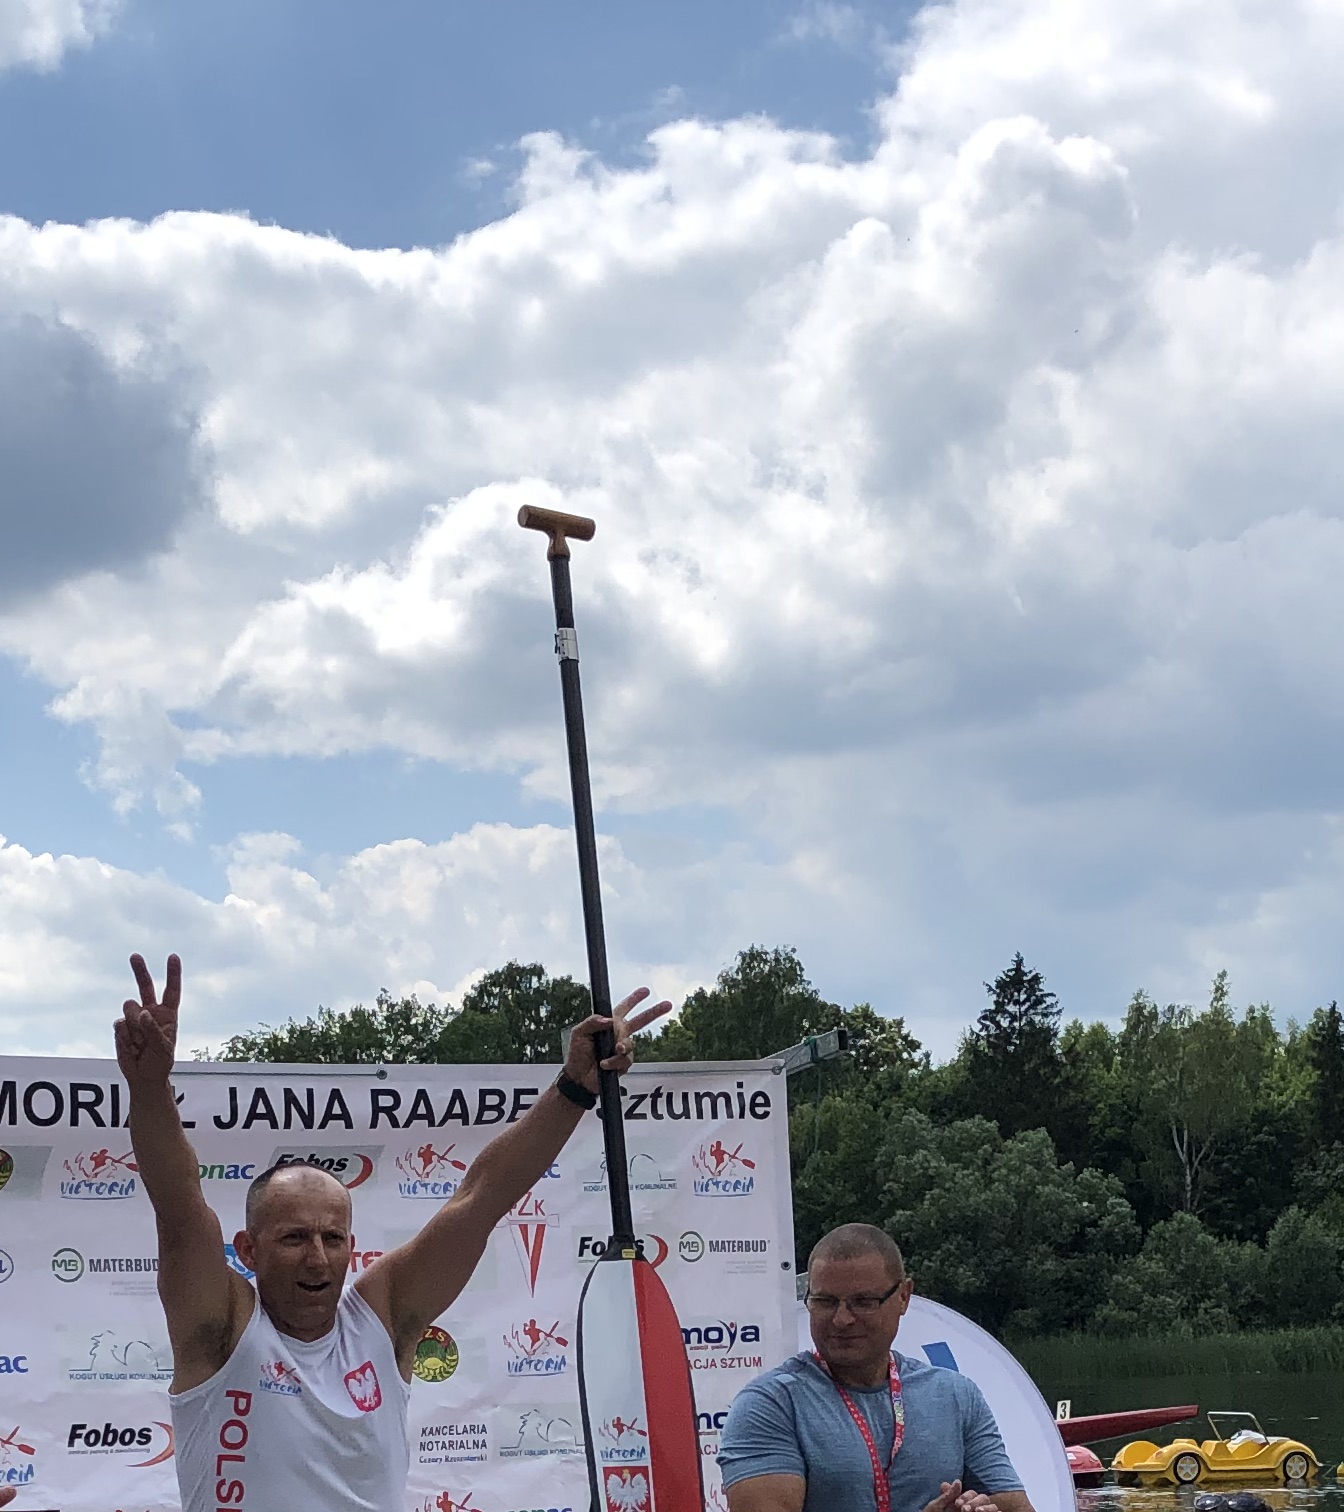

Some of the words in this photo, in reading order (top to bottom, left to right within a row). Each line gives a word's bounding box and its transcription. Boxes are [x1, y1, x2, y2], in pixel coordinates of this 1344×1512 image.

[213, 1087, 353, 1130] JANA
[89, 1258, 159, 1272] MATERBUD
[720, 1356, 762, 1369] SZTUM
[1059, 1402, 1067, 1419] 3
[67, 1422, 153, 1448] Fobos
[421, 1424, 488, 1437] KANCELARIA
[419, 1439, 488, 1452] NOTARIALNA
